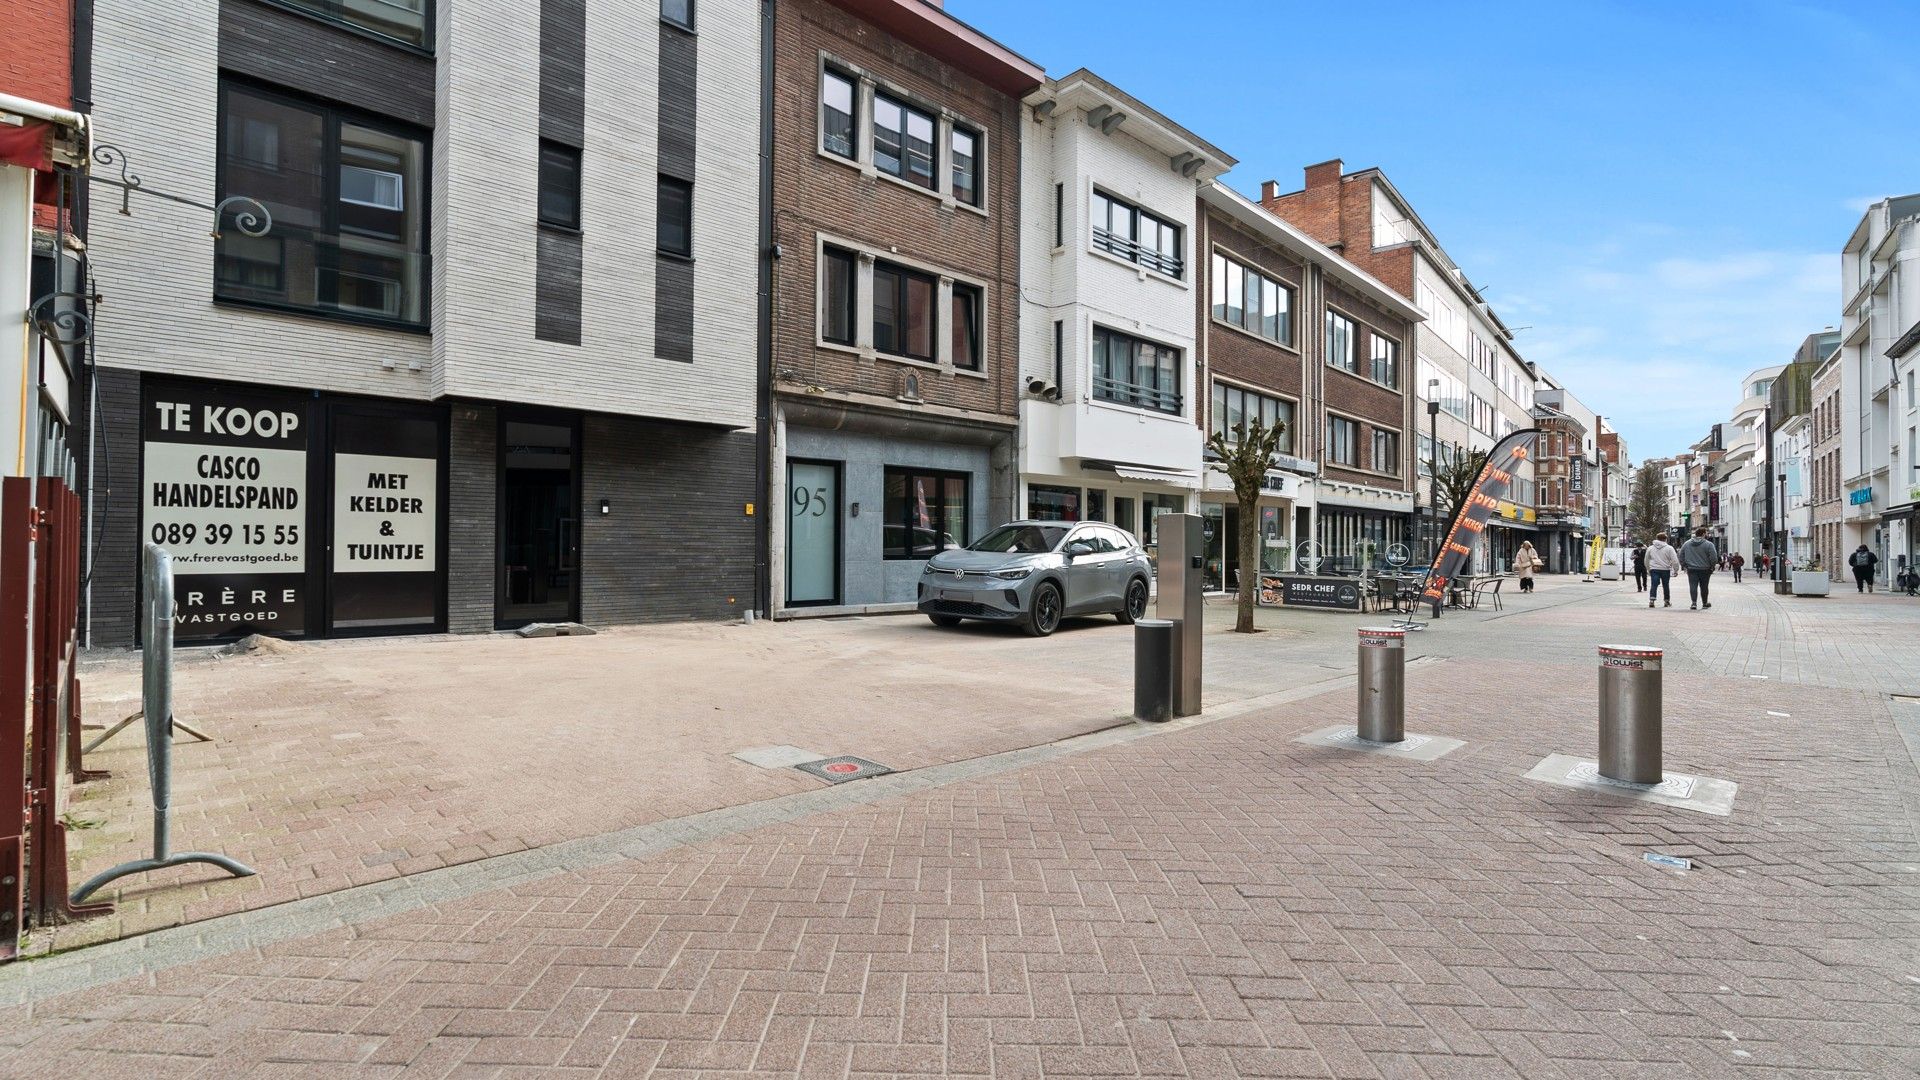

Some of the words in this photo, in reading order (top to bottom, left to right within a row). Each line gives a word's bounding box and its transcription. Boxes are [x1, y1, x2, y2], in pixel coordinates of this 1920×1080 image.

[156, 401, 191, 431] TE
[204, 405, 299, 438] KOOP
[1512, 446, 1528, 458] CD
[197, 454, 261, 480] CASCO
[367, 472, 409, 490] MET
[153, 482, 298, 510] HANDELSPAND
[350, 495, 423, 514] KELDER
[794, 486, 827, 517] 95
[1475, 493, 1498, 510] DVD
[151, 522, 197, 545] 089
[204, 523, 233, 545] 39
[243, 524, 266, 545] 15
[273, 525, 299, 545] 55
[379, 520, 395, 537] &
[173, 553, 299, 564] w.frerevastgoed.be
[347, 544, 424, 560] TUINTJE
[188, 587, 296, 606] RÈRE
[1291, 583, 1312, 592] SEDR
[1314, 585, 1335, 593] CHEF
[177, 611, 278, 624] VASTGOED
